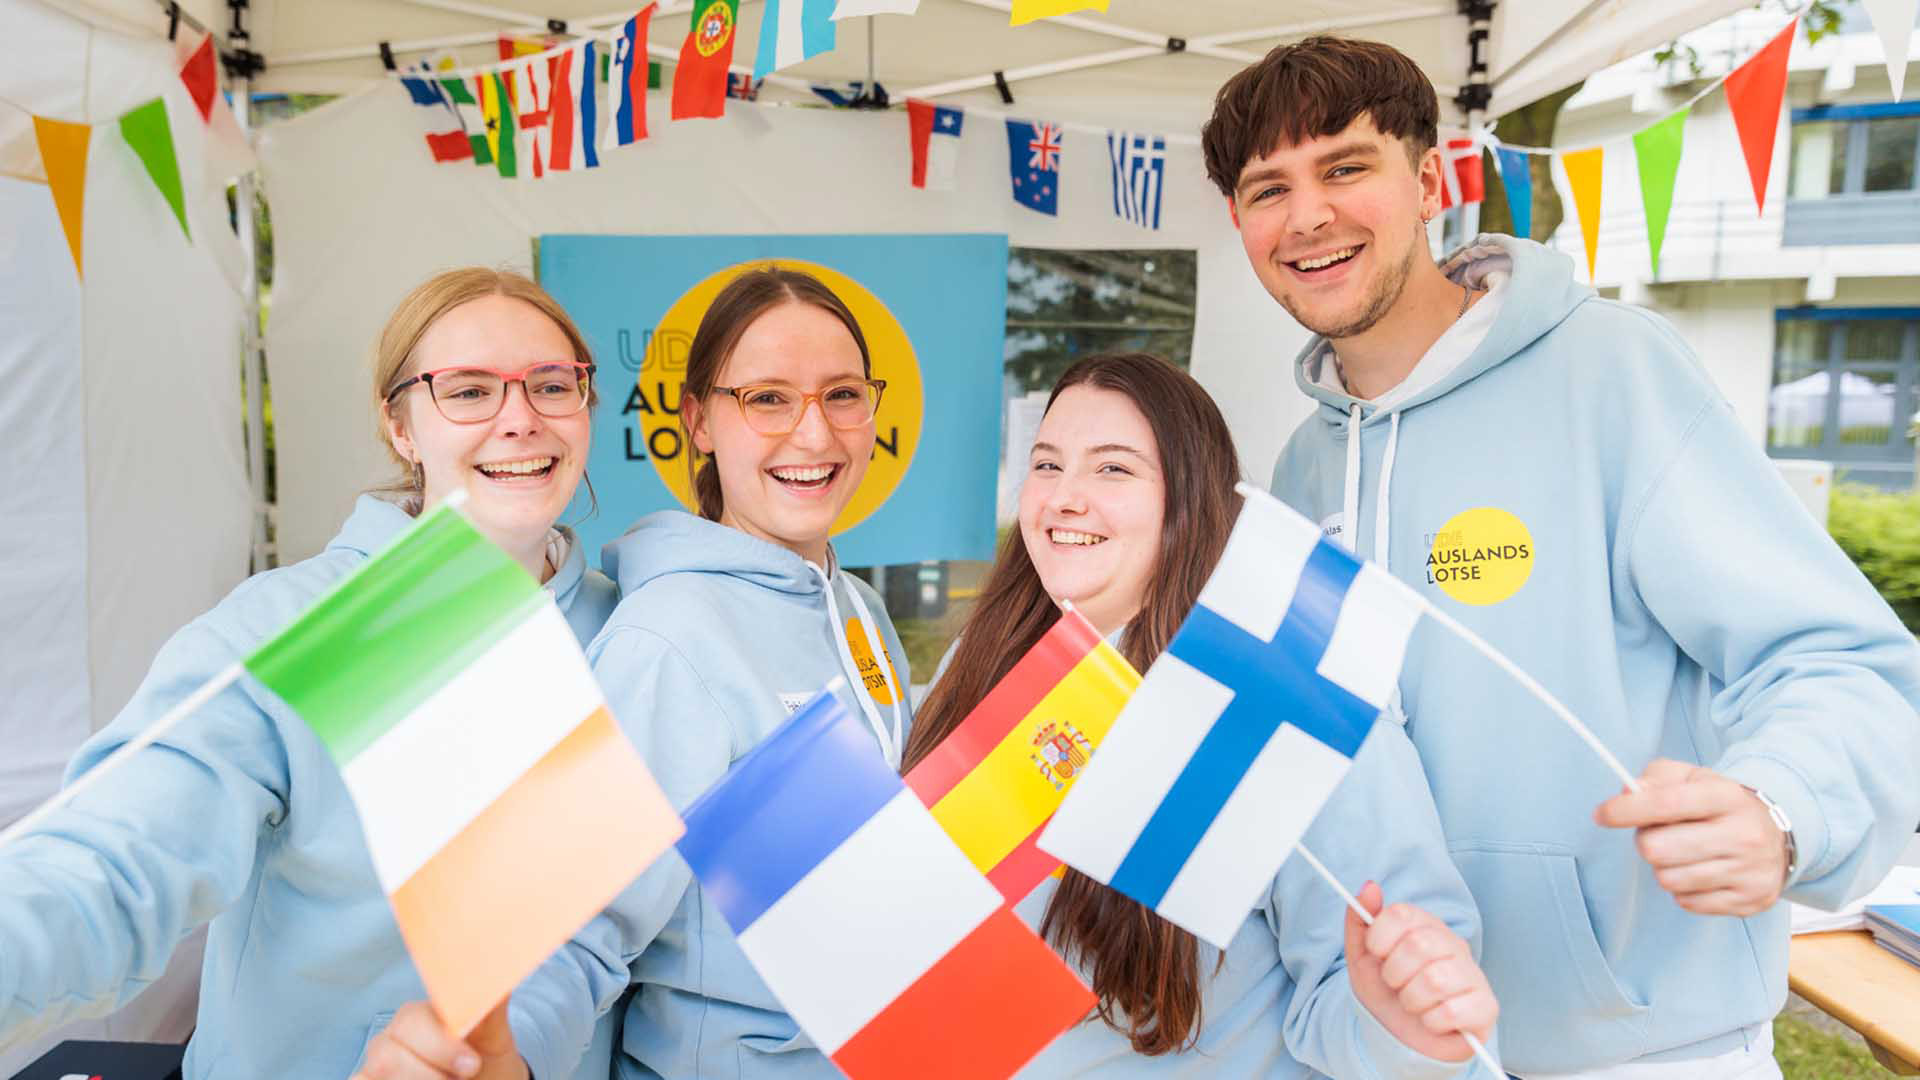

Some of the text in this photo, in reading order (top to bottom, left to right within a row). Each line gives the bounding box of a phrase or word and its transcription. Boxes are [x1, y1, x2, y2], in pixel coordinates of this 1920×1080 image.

[617, 329, 688, 373] UD
[1426, 545, 1530, 566] AUSLANDS
[1426, 566, 1481, 584] LOTSE
